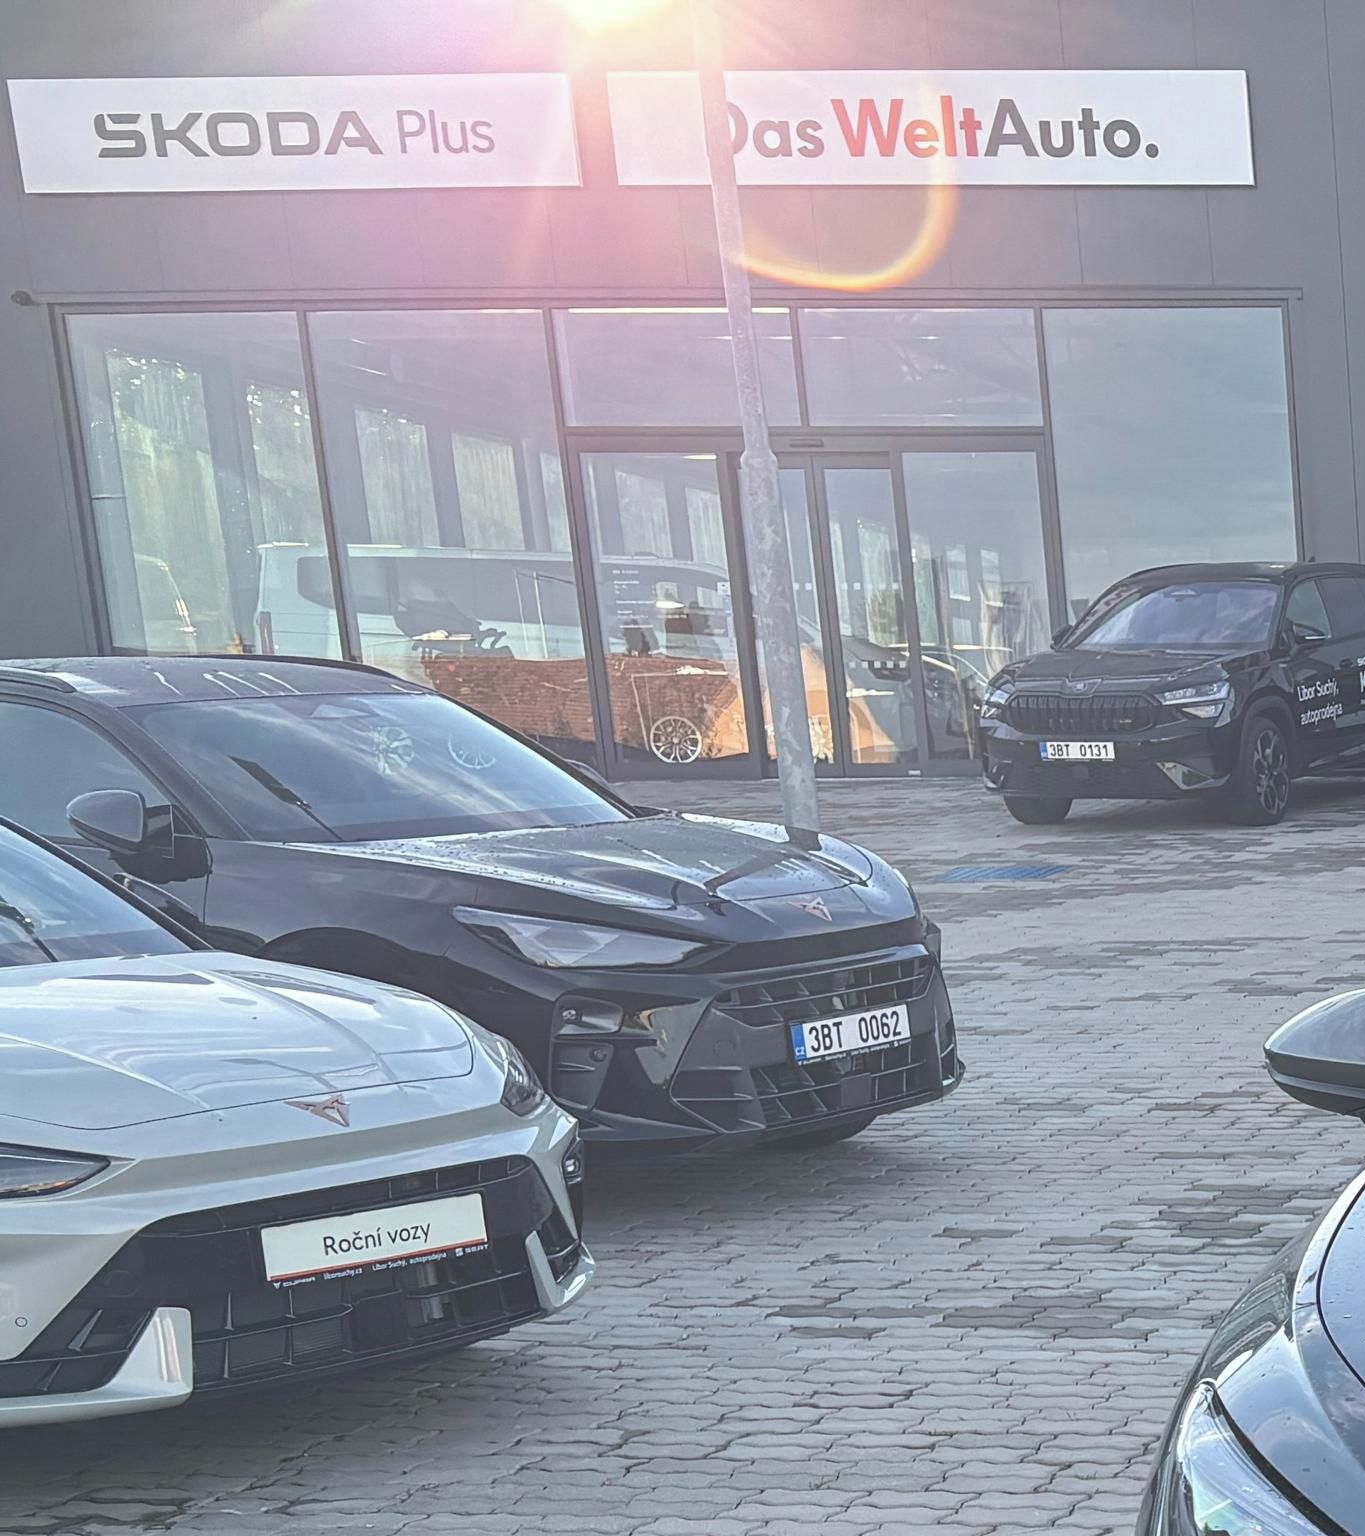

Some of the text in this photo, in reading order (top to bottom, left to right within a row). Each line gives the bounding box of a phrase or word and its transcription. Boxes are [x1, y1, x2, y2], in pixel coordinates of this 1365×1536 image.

[396, 109, 496, 154] Plus
[830, 95, 1159, 159] WeltAuto.
[1049, 744, 1108, 757] 3BT 0131
[809, 1011, 902, 1053] 3BT 0062
[323, 1223, 431, 1256] Roční vozy
